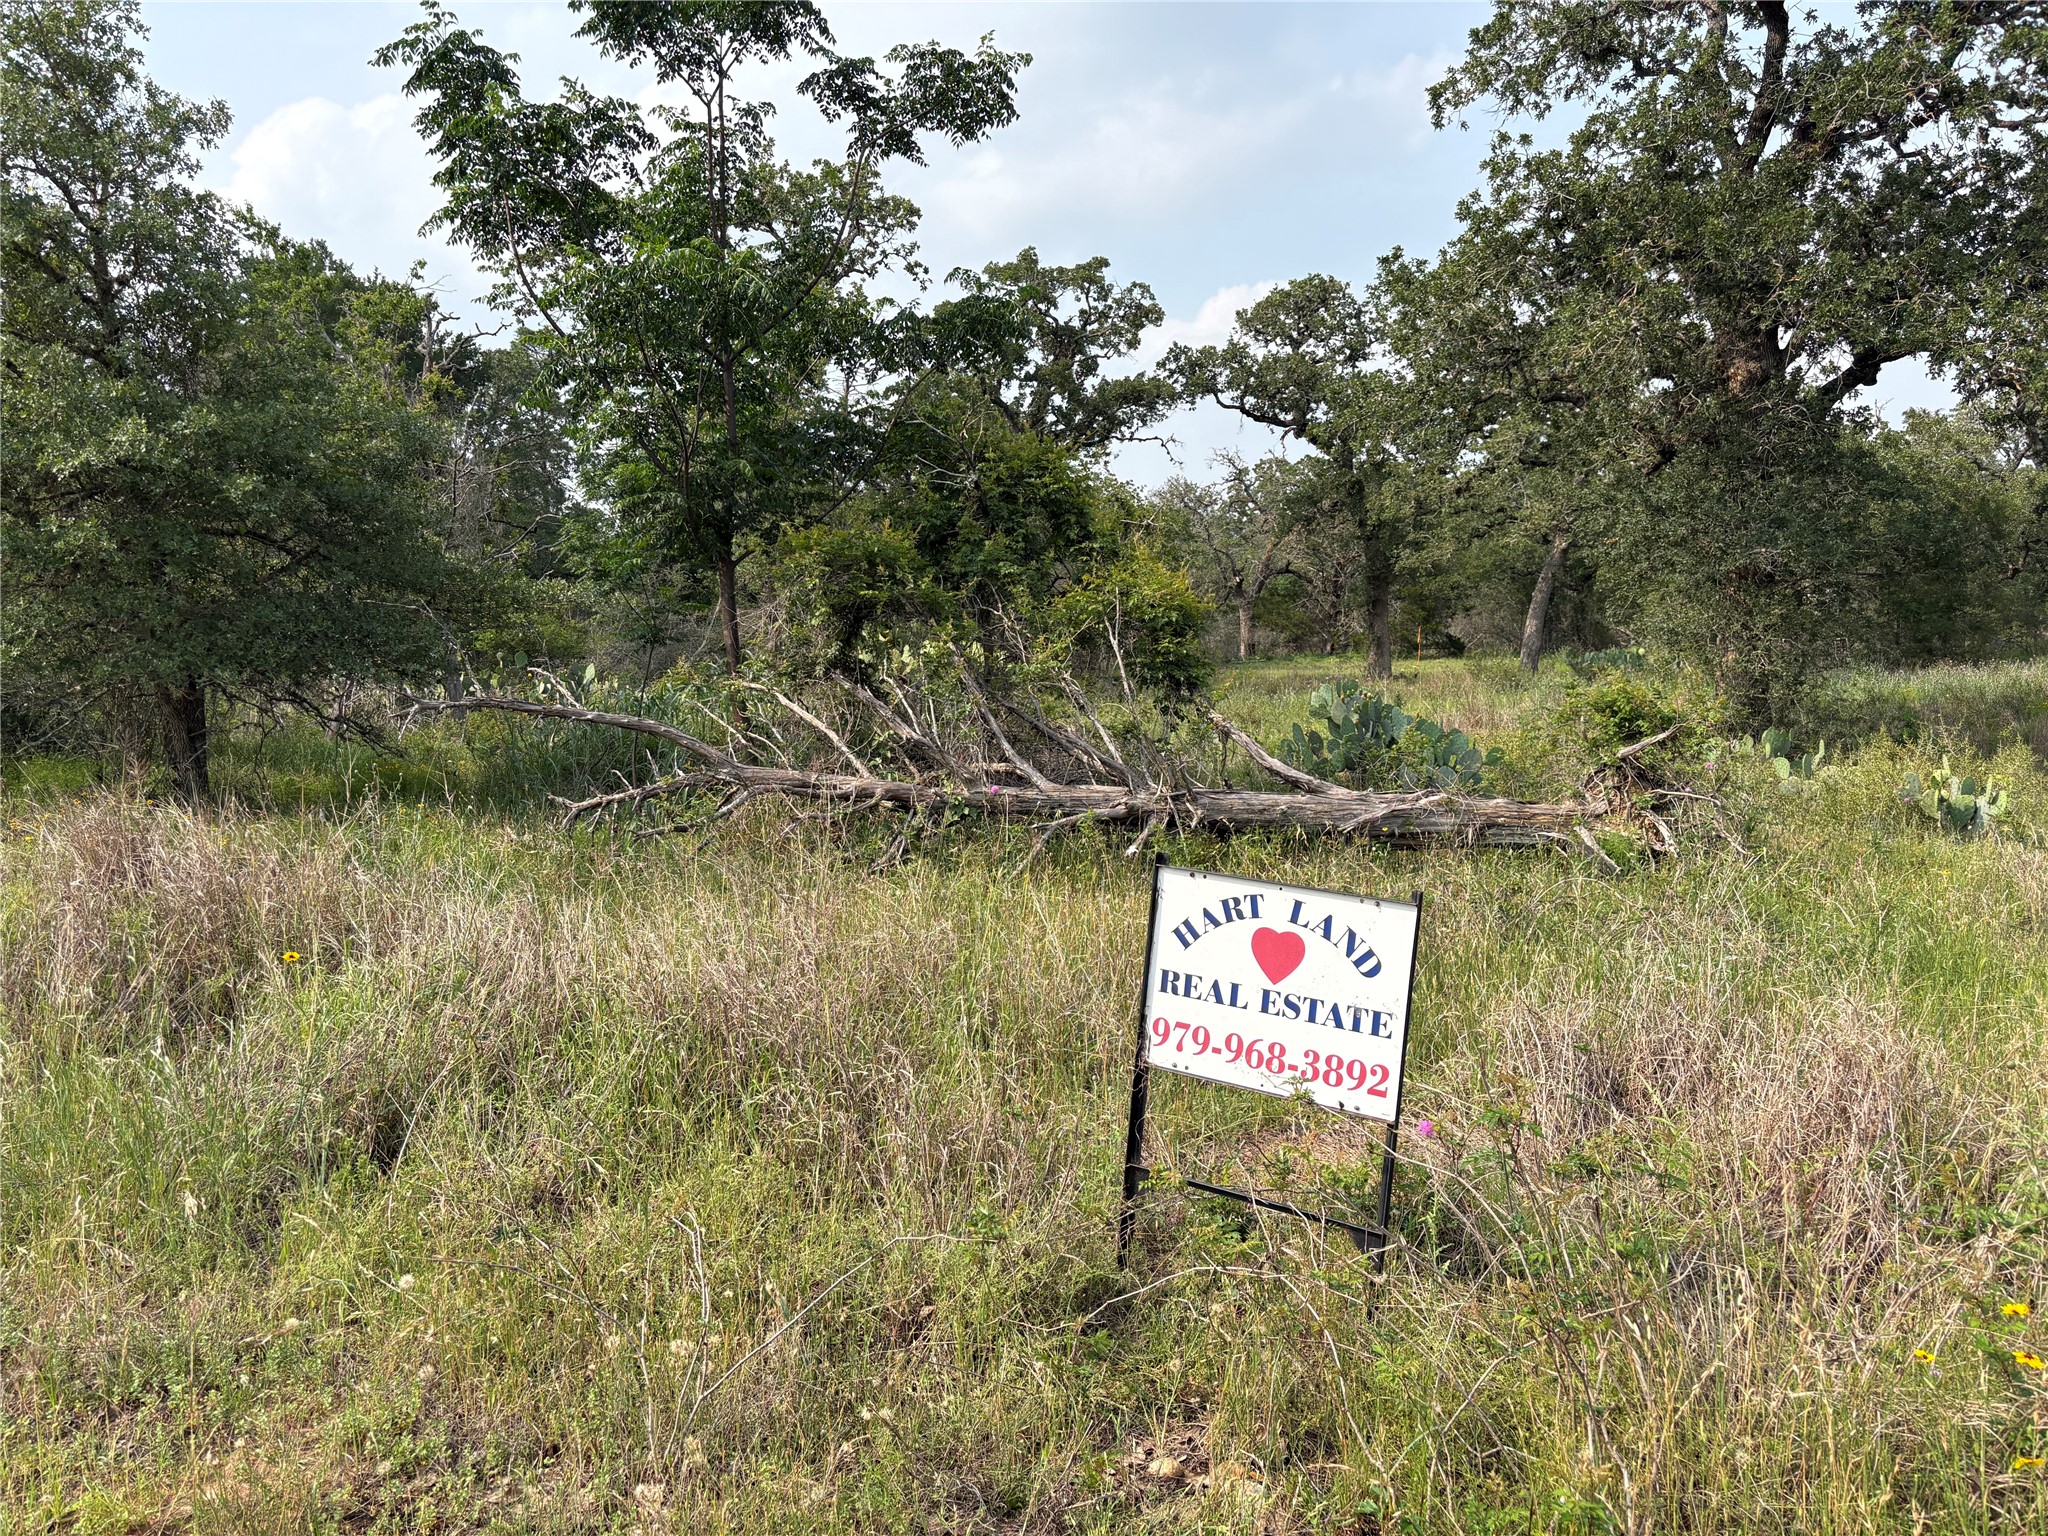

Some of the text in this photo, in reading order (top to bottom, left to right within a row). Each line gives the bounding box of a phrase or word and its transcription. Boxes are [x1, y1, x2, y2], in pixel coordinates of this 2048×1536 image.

[1171, 894, 1382, 978] HART LAND
[1158, 968, 1394, 1039] REAL ESTATE
[1152, 1017, 1390, 1098] 979-968-3892
